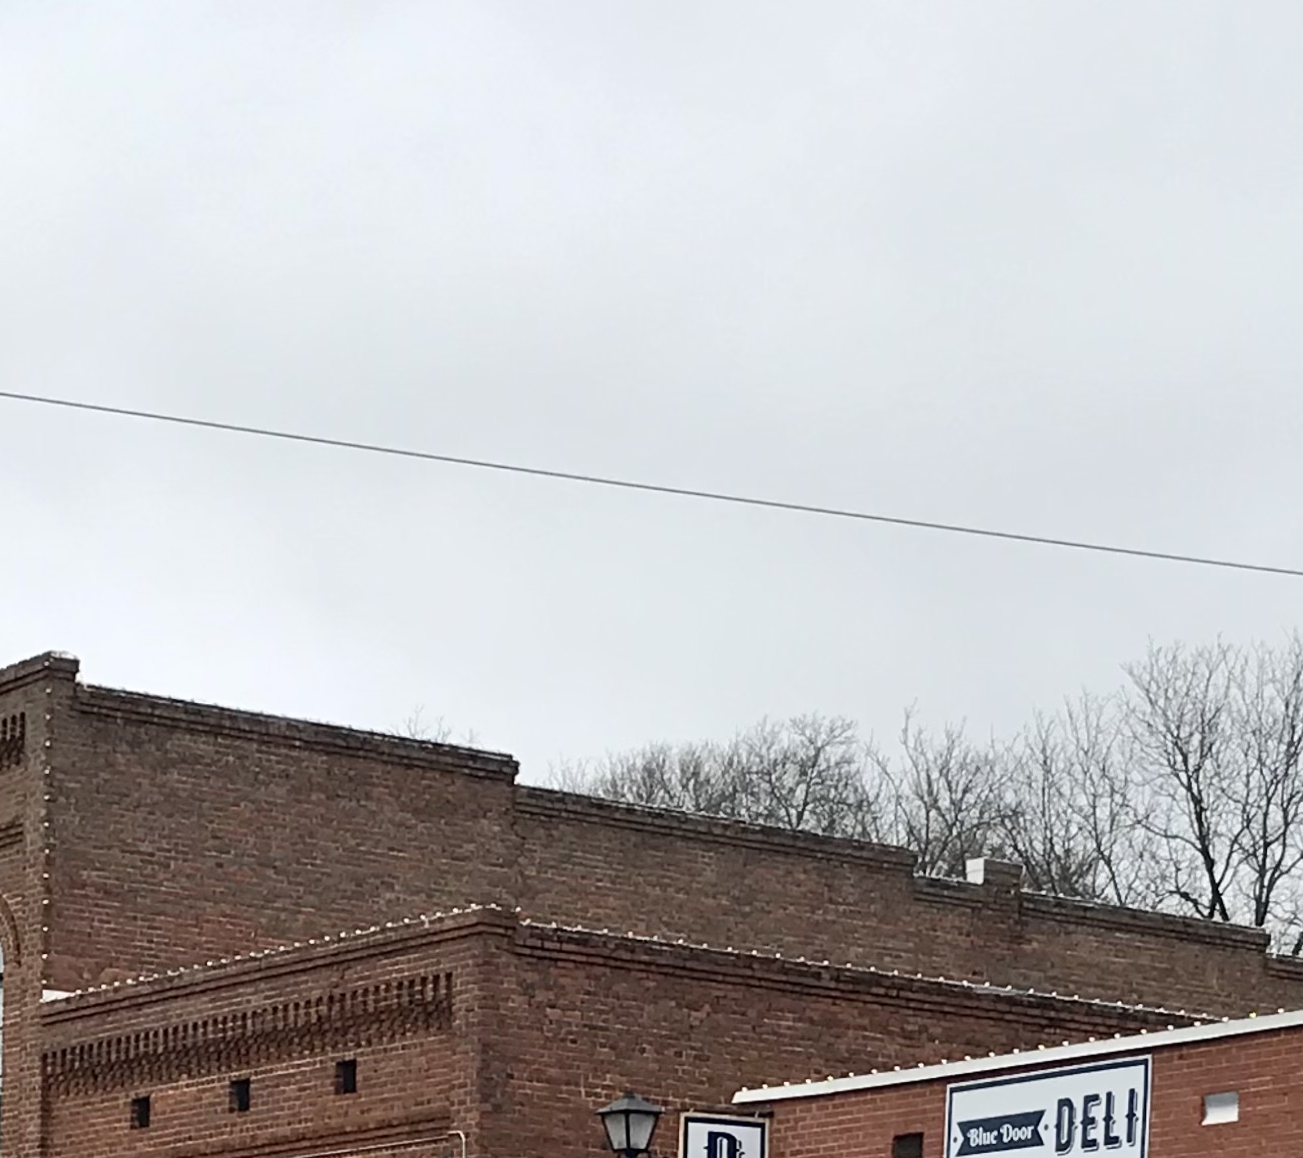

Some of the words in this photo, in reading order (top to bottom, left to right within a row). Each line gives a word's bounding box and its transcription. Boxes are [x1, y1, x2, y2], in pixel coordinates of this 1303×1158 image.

[966, 1128, 998, 1147] Blue
[1000, 1122, 1034, 1143] Door
[1054, 1087, 1140, 1156] DELI
